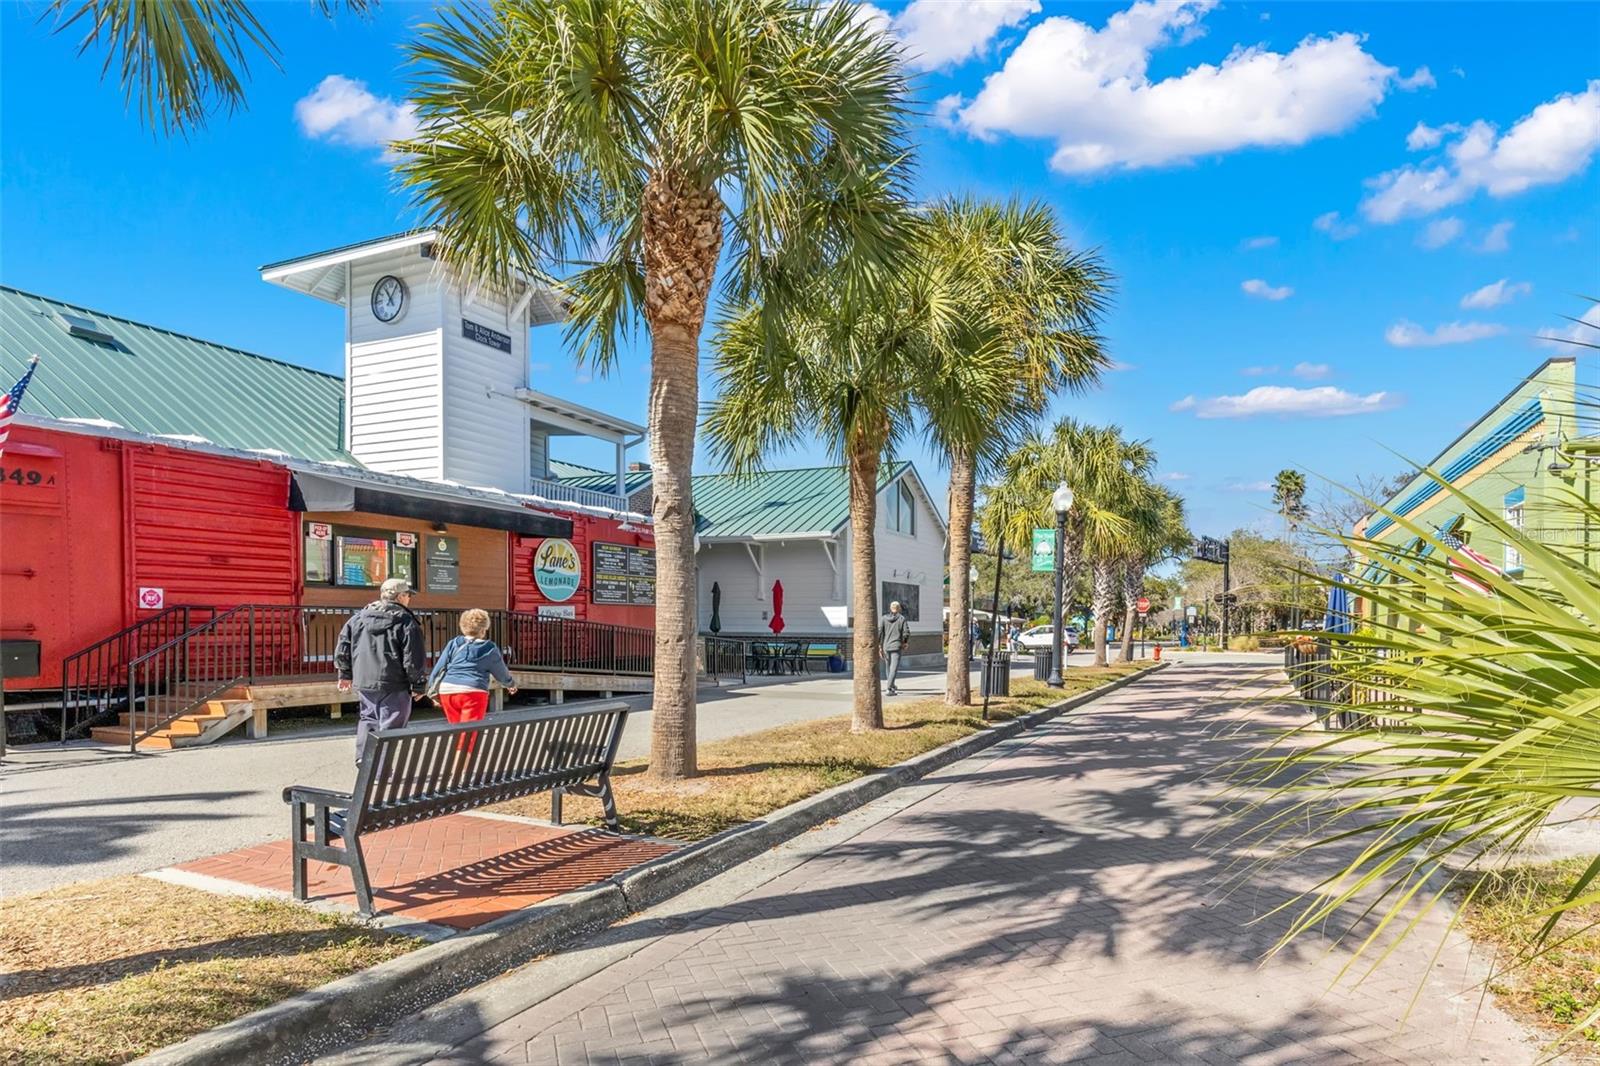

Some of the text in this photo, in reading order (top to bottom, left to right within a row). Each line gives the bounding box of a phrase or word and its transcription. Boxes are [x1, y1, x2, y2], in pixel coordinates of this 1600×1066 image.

[475, 333, 501, 348] Clock Tower
[491, 331, 511, 344] Anderson
[538, 544, 576, 573] Lane's
[540, 575, 575, 587] LEMONADE
